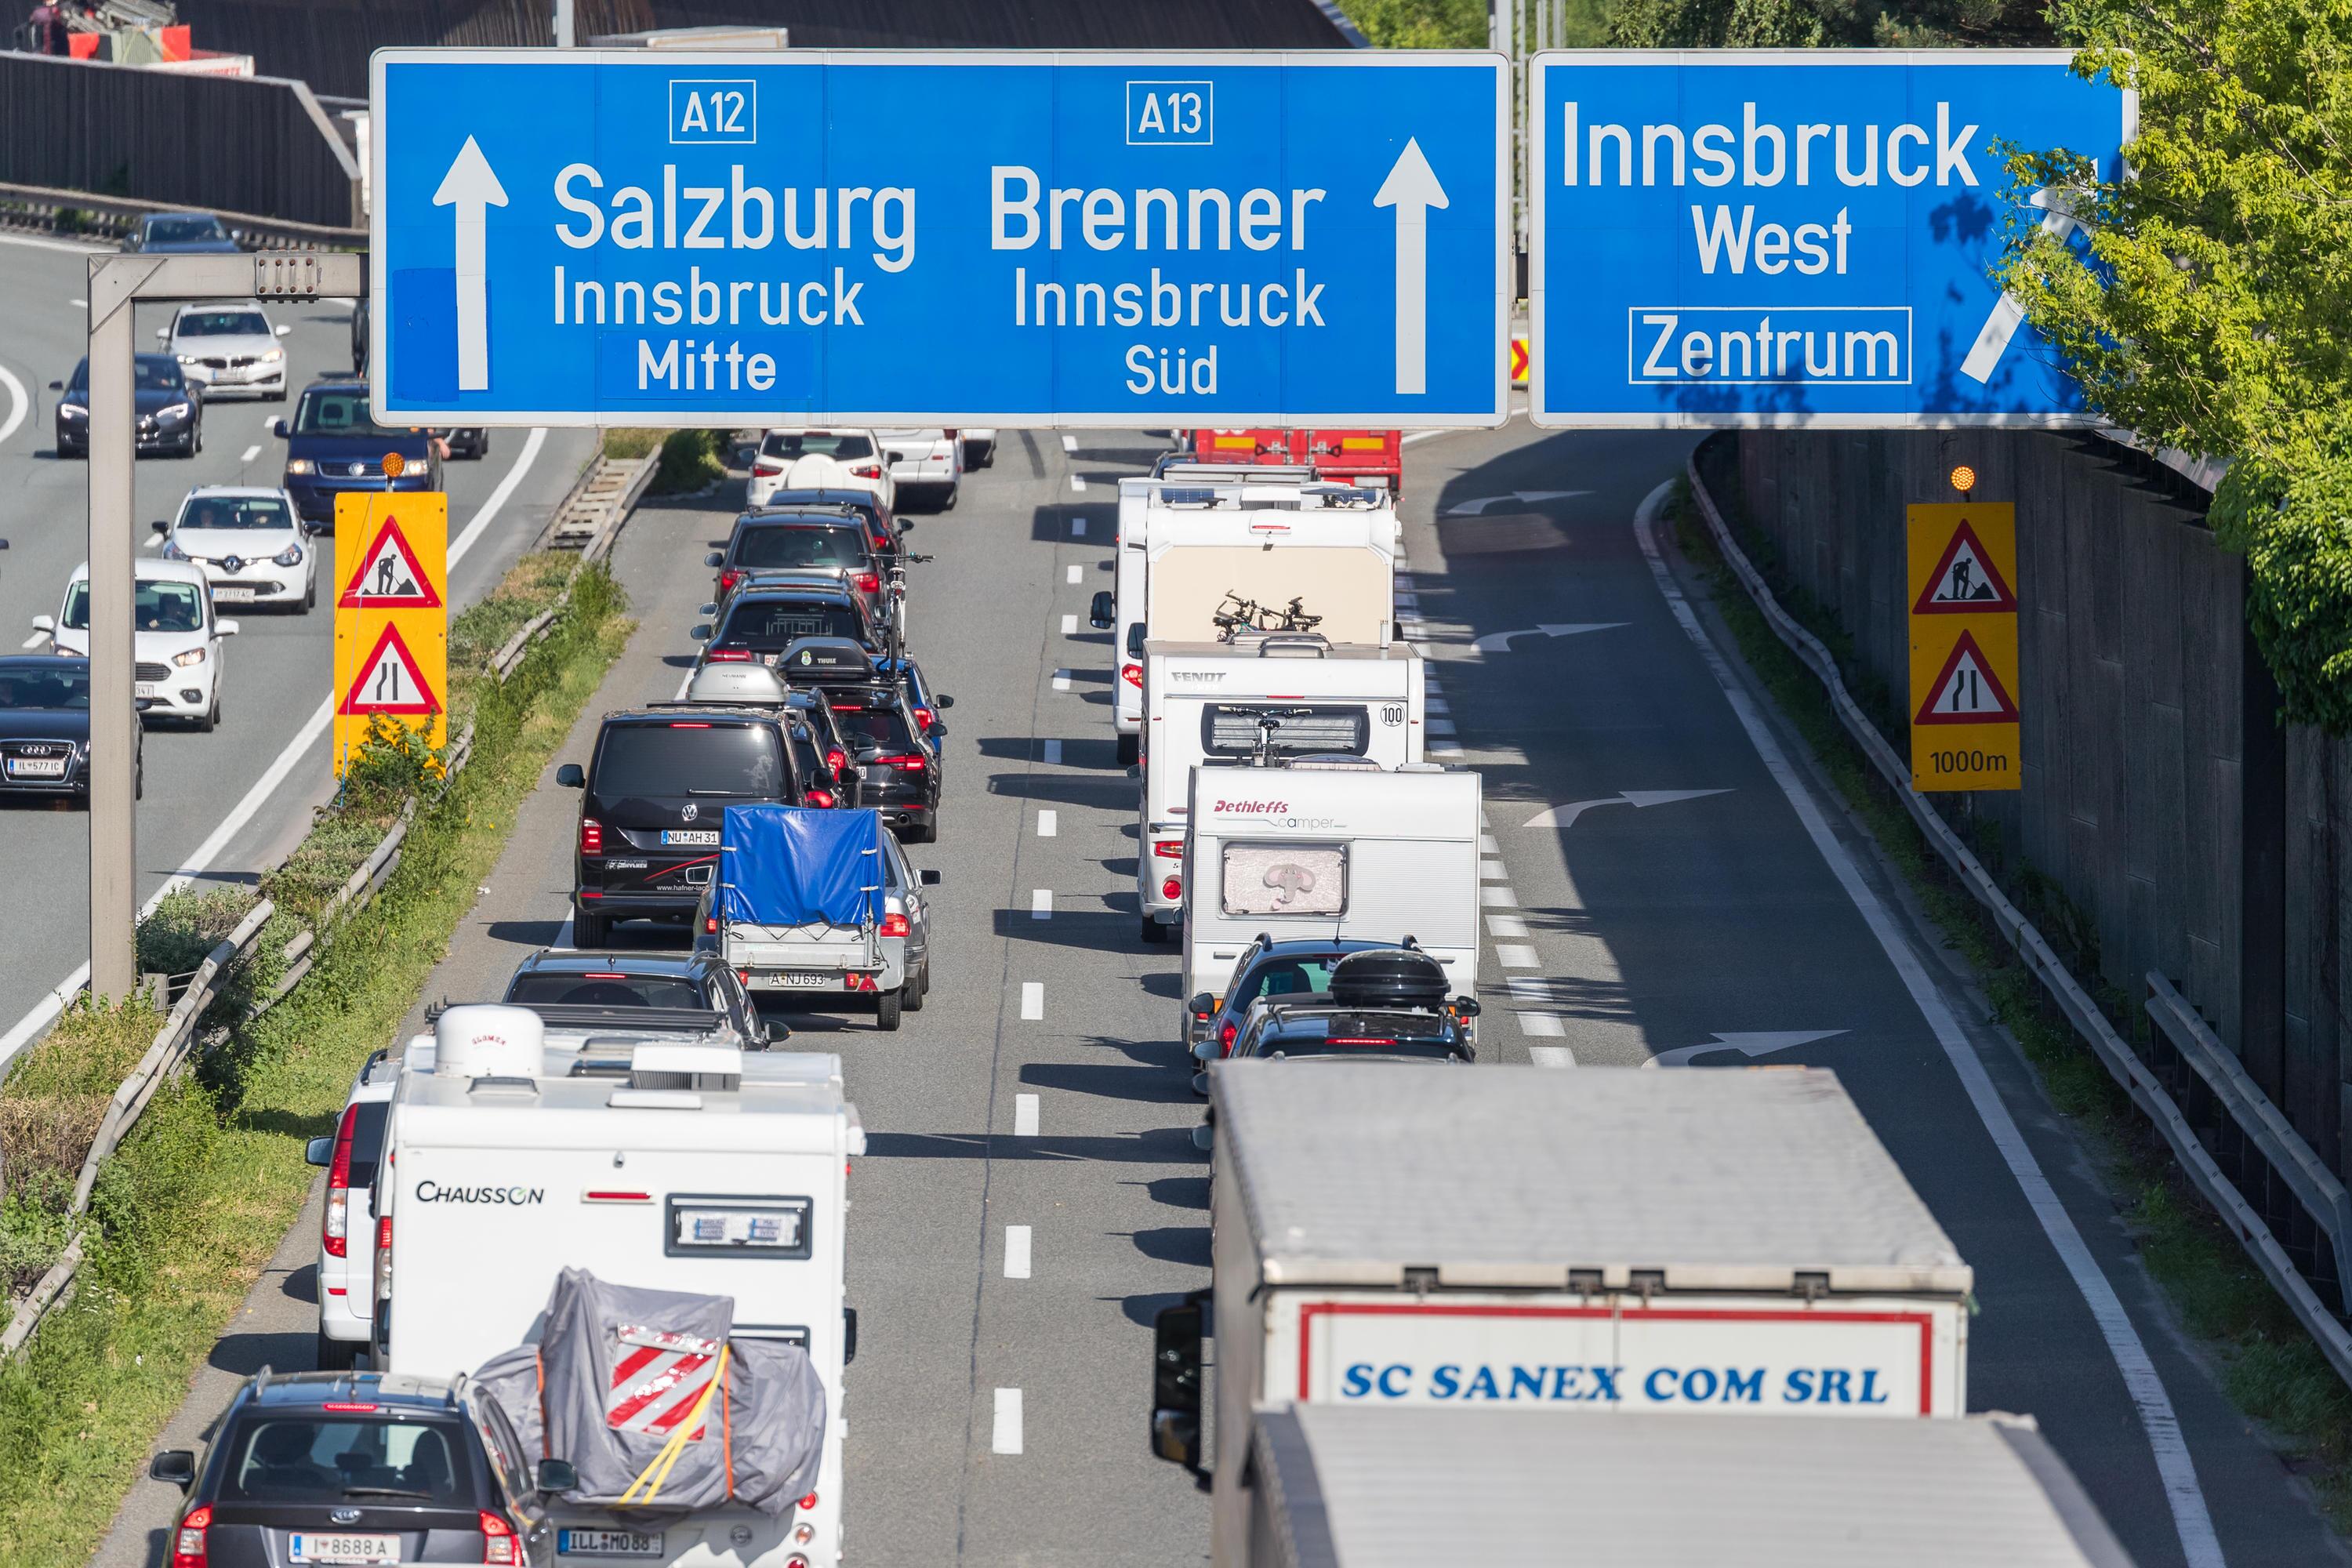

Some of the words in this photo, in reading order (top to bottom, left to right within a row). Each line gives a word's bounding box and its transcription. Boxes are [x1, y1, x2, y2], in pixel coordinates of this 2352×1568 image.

[681, 91, 745, 132] A12
[1138, 93, 1202, 134] A13
[1564, 101, 1980, 187] Innsbruck
[554, 162, 915, 273] Salzburg
[991, 165, 1327, 251] Brenner
[1691, 205, 1852, 275] West
[554, 266, 865, 325] Innsbruck
[1016, 267, 1326, 327] Innsbruck
[638, 339, 776, 390] Mitte
[1642, 314, 1899, 377] Zentrum
[1125, 344, 1218, 395] Süd
[1171, 672, 1226, 682] FENDT
[1382, 707, 1402, 723] 100
[19, 761, 26, 770] IL
[33, 761, 49, 770] 577
[1929, 750, 2007, 773] 1000m
[1214, 800, 1289, 813] Dethleffs
[1277, 817, 1334, 831] camper
[668, 833, 681, 842] NU
[688, 833, 702, 843] AH
[704, 833, 717, 843] 31
[771, 973, 779, 984] A
[786, 973, 800, 985] NJ
[804, 973, 824, 985] 693
[1341, 1363, 1414, 1399] SC
[1429, 1364, 1624, 1402] SANEX
[1643, 1367, 1766, 1403] COM
[1783, 1368, 1888, 1404] SRL
[332, 1539, 372, 1555] 8688
[376, 1541, 387, 1555] A
[570, 1533, 597, 1550] ILL
[611, 1534, 628, 1551] MO
[632, 1534, 649, 1551] 88
